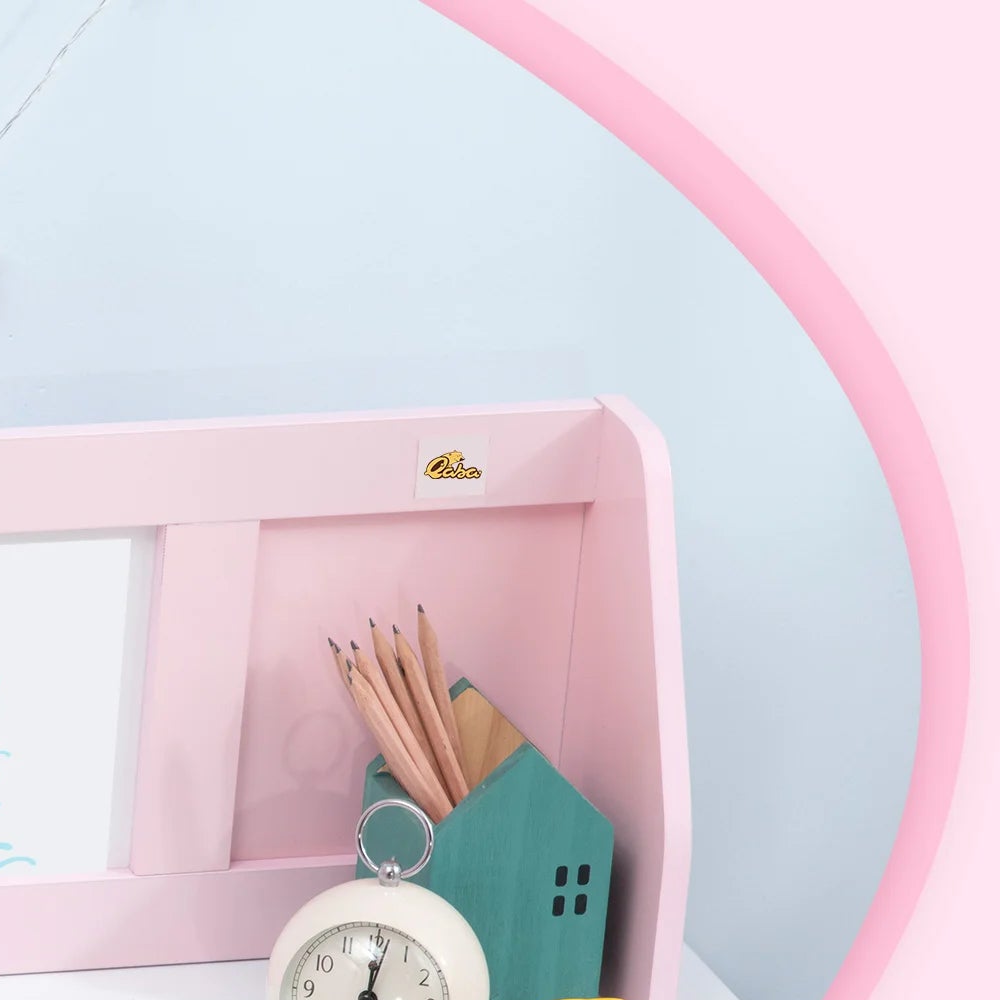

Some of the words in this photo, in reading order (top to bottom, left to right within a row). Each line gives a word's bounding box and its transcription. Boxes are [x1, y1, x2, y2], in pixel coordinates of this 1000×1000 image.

[342, 936, 353, 954] 11
[403, 945, 408, 963] 1
[316, 954, 334, 973] 10
[419, 968, 430, 987] 2
[303, 979, 315, 998] 9
